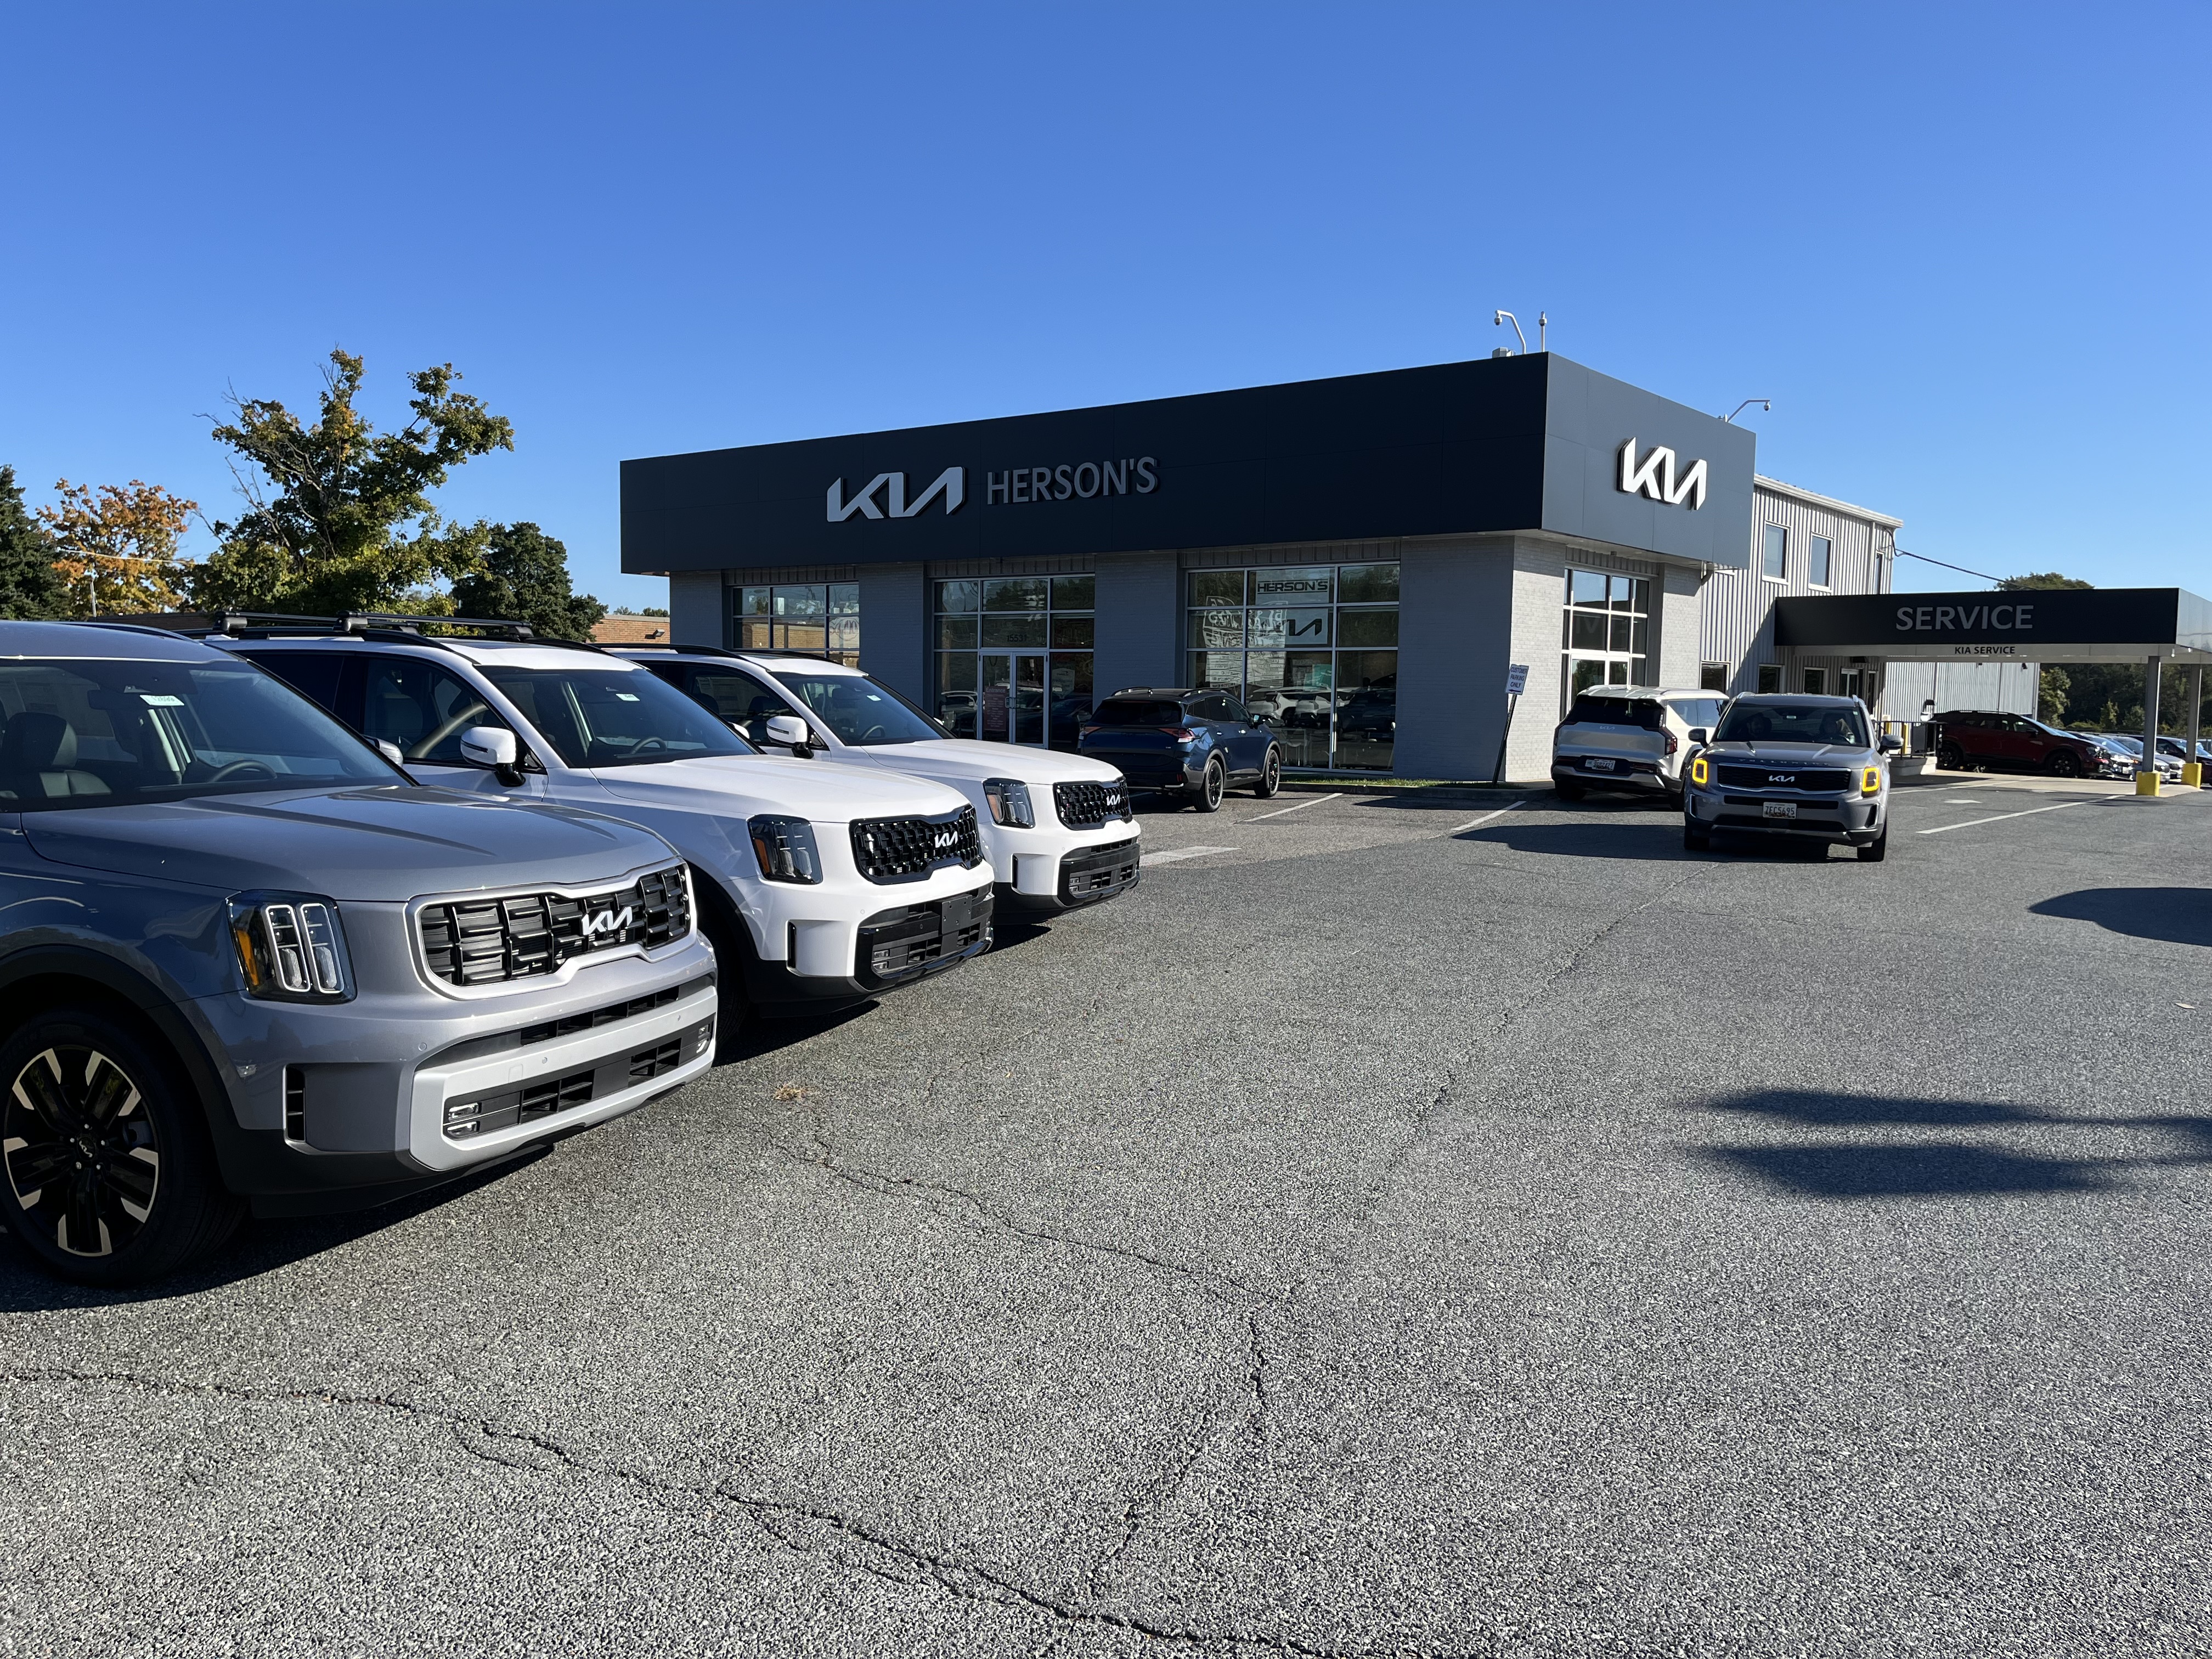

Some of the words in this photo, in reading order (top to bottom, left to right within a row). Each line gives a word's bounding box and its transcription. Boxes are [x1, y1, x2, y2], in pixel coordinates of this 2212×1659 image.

[1621, 437, 1707, 511] KIA
[827, 466, 965, 522] KIA
[987, 456, 1158, 505] HERSON'S
[1257, 580, 1328, 592] HERSON'S
[1895, 605, 2034, 630] SERVICE
[1954, 646, 1972, 654] KIA
[1974, 646, 2016, 654] SERVICE
[1106, 794, 1121, 806] KIA
[934, 830, 958, 848] KIA
[582, 906, 633, 936] KIA
